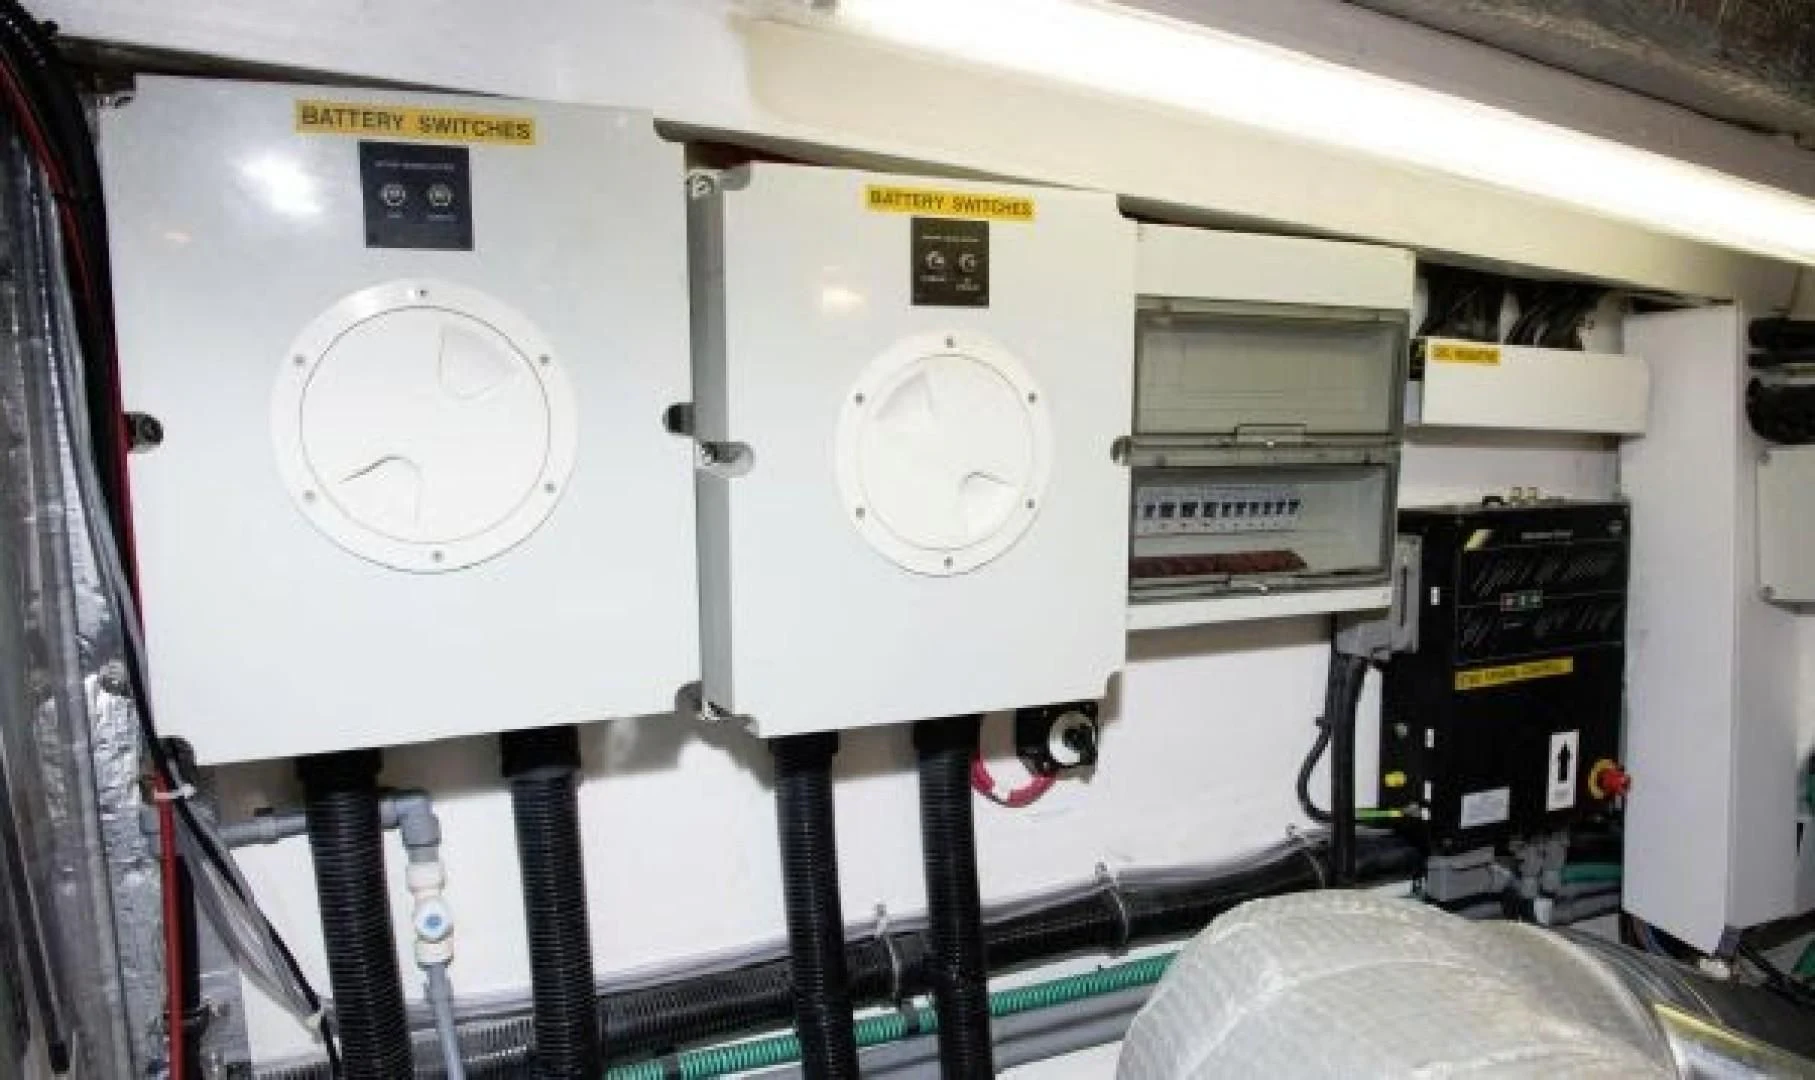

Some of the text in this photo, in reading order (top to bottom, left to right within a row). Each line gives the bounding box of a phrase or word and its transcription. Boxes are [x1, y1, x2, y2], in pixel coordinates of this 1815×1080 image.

[302, 105, 531, 139] BATTERY SWITCHES
[870, 190, 1033, 218] BATTERY SWITCHES
